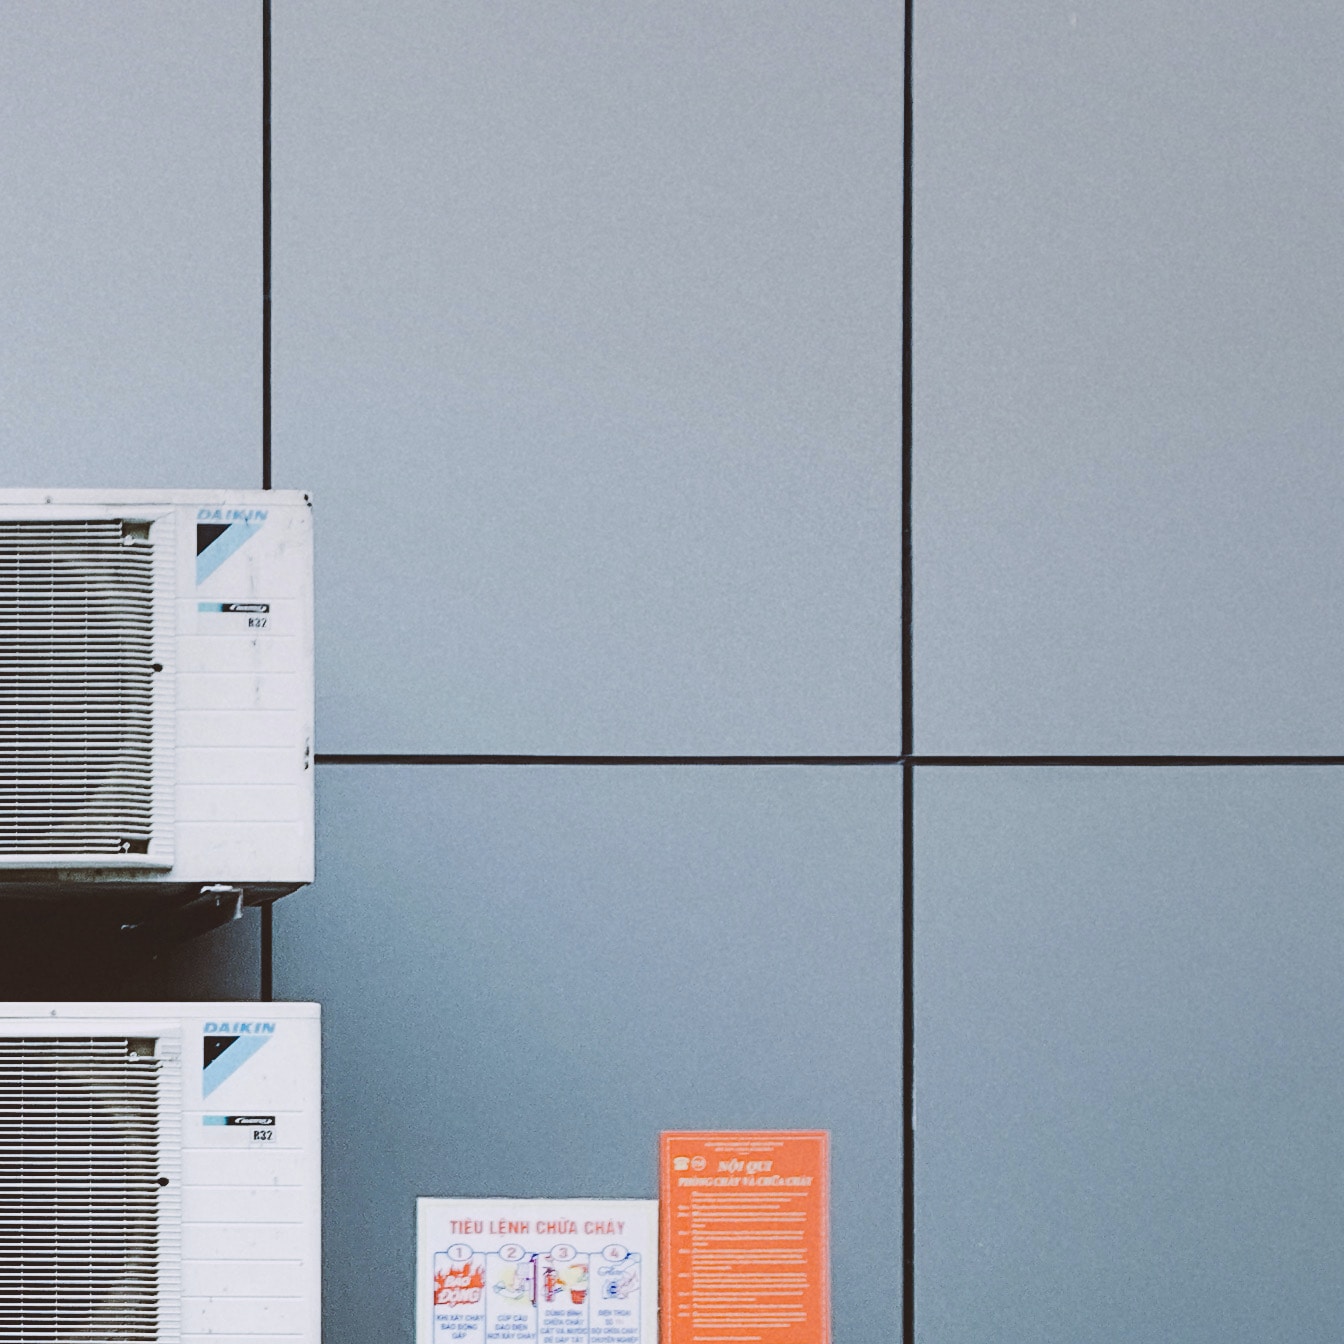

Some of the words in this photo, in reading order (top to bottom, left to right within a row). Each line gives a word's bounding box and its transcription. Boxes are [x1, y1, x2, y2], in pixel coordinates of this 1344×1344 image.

[197, 509, 268, 520] DAIKIN
[203, 1022, 276, 1033] DAIKIN
[253, 1130, 273, 1140] R32
[450, 1216, 483, 1235] TIÊU
[489, 1216, 530, 1238] LỆNH
[536, 1216, 578, 1235] CHỮA
[584, 1216, 625, 1235] CHÁY
[455, 1247, 463, 1258] 1
[506, 1247, 517, 1258] 2
[558, 1247, 569, 1258] 3
[609, 1247, 620, 1258] 4
